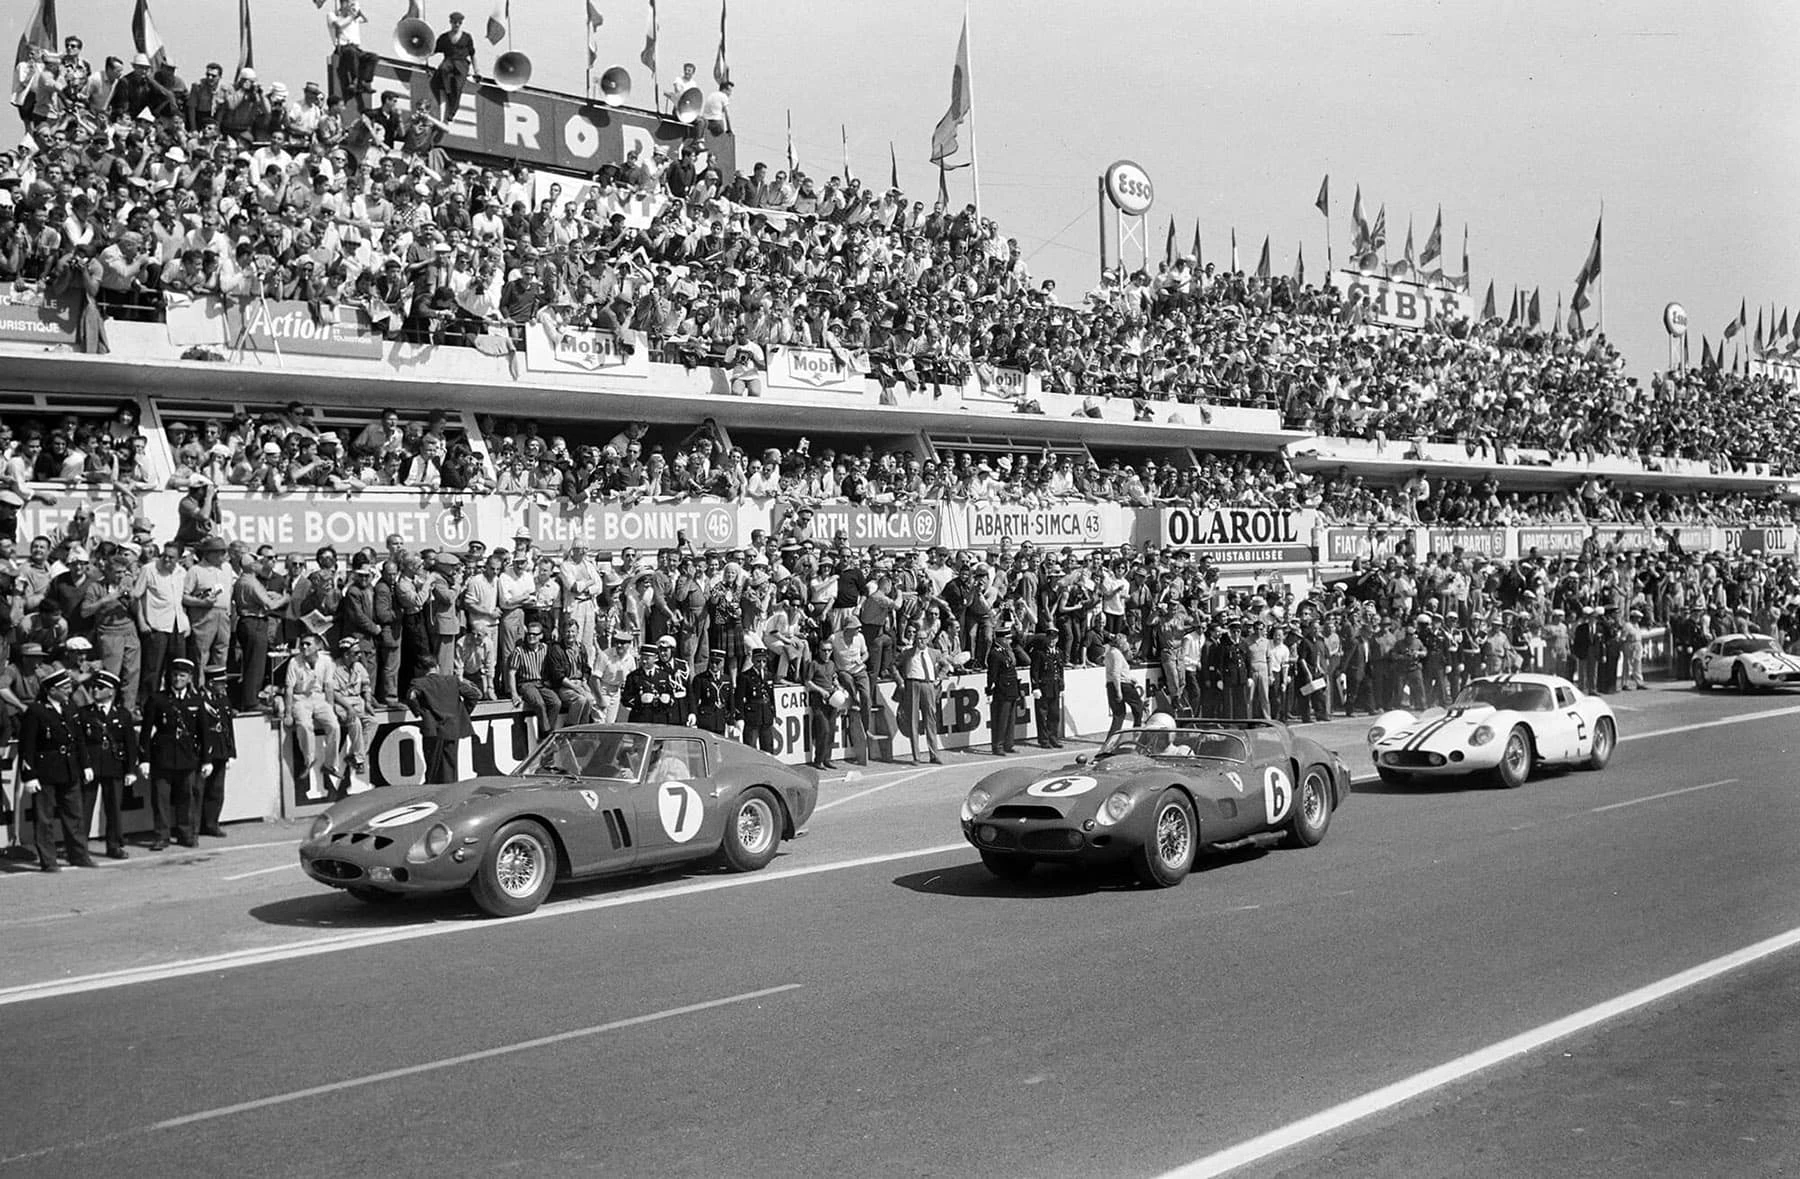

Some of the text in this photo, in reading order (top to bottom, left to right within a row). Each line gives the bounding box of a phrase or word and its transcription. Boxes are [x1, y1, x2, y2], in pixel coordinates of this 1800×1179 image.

[1118, 173, 1151, 201] Esso
[220, 509, 293, 543] RENÉ
[304, 511, 430, 543] BONNET
[537, 511, 729, 541] RENÉ BONNET 46
[855, 512, 912, 538] SIMCA
[917, 515, 934, 536] 62
[1085, 515, 1100, 533] 43
[1168, 509, 1298, 545] OLAROIL
[1335, 535, 1358, 554] FIAT
[1567, 711, 1587, 741] 2
[1041, 777, 1081, 793] 6
[1270, 771, 1285, 817] 6
[666, 786, 689, 833] 7
